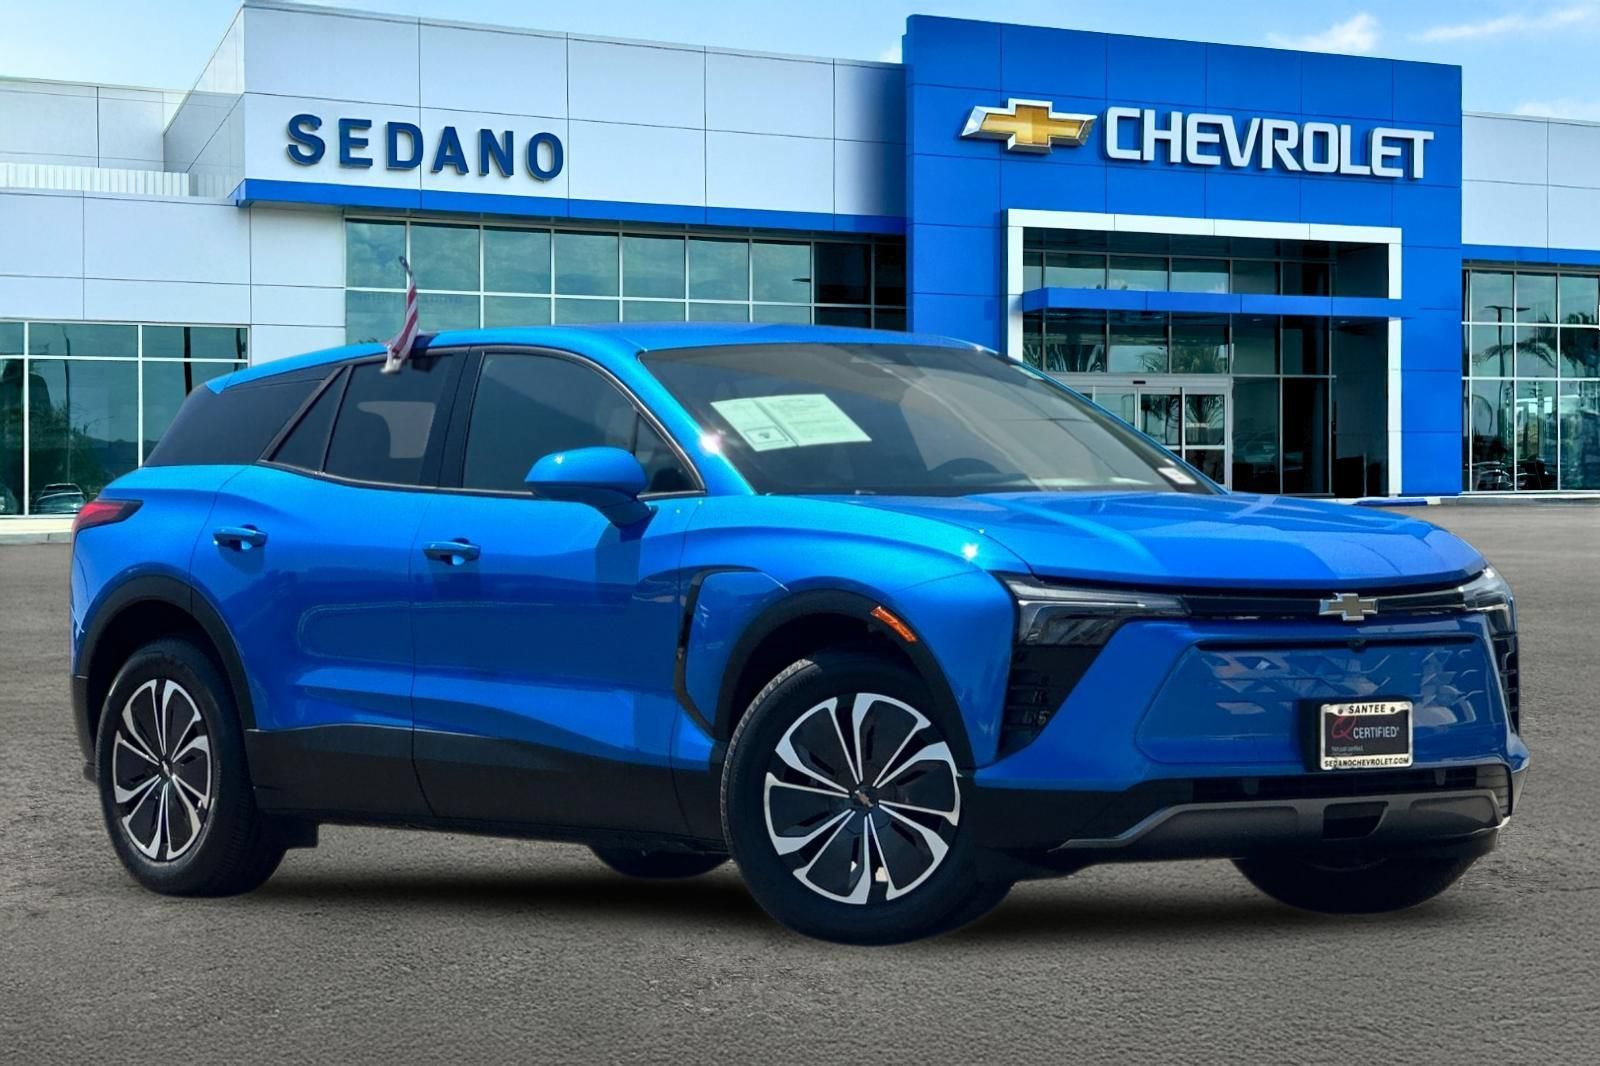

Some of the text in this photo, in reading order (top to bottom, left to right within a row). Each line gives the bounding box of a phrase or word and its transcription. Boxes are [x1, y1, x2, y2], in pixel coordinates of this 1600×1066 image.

[287, 114, 564, 181] SEDANO
[1106, 106, 1434, 178] CHEVROLET
[1348, 704, 1386, 714] SANTEE
[1324, 757, 1409, 768] SEDANOCHEVROLET.COM
